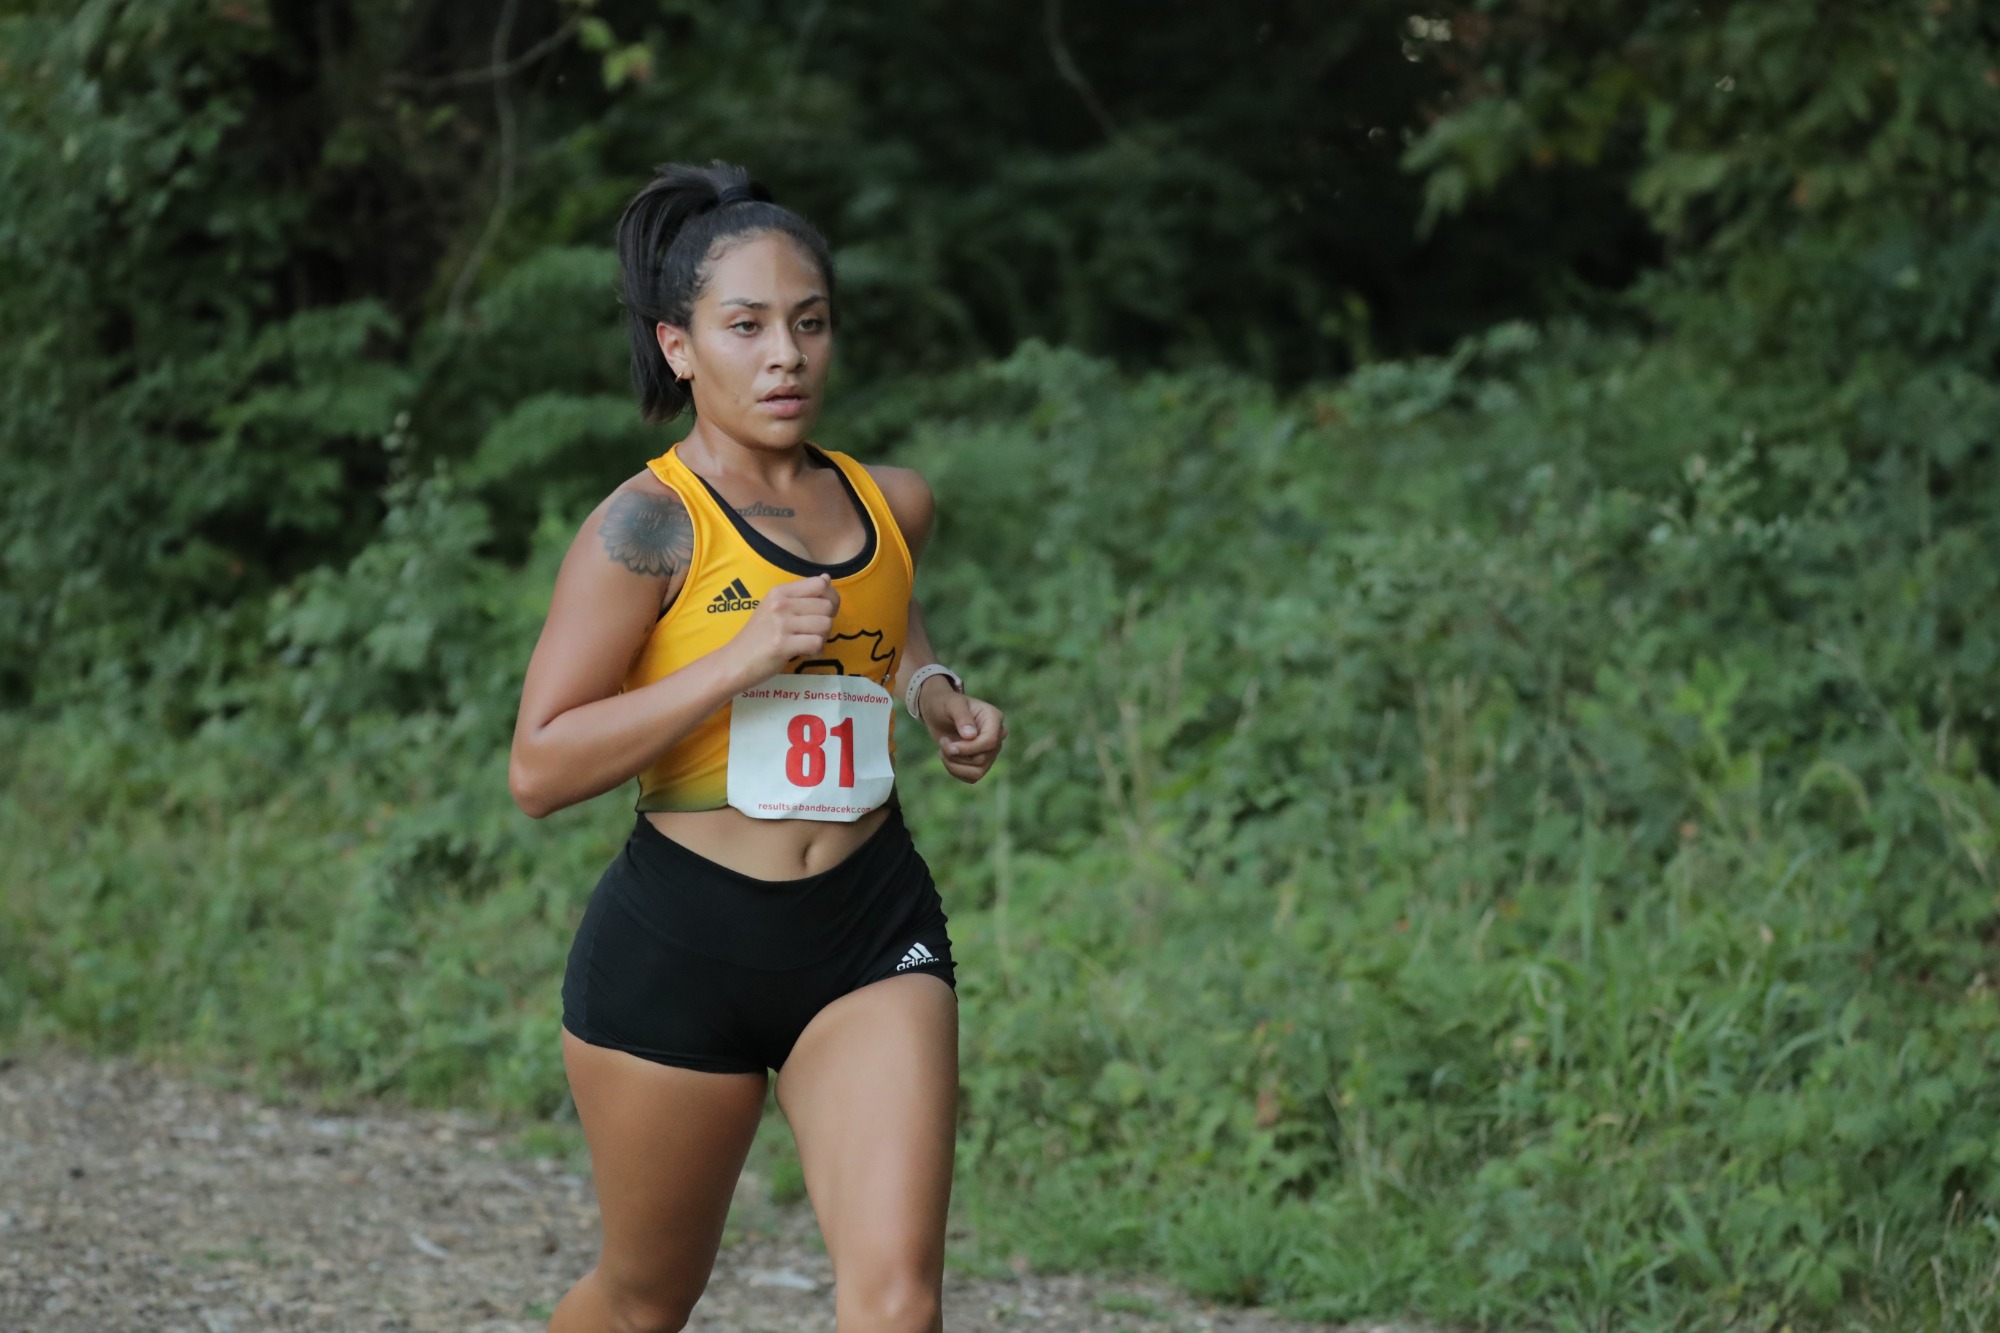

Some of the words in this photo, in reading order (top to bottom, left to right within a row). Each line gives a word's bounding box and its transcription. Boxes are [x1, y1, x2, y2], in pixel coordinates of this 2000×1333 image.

[742, 689, 769, 699] Saint
[773, 690, 800, 701] Mary
[804, 690, 842, 701] Sunset
[843, 692, 889, 705] Showdown
[785, 714, 855, 788] 81
